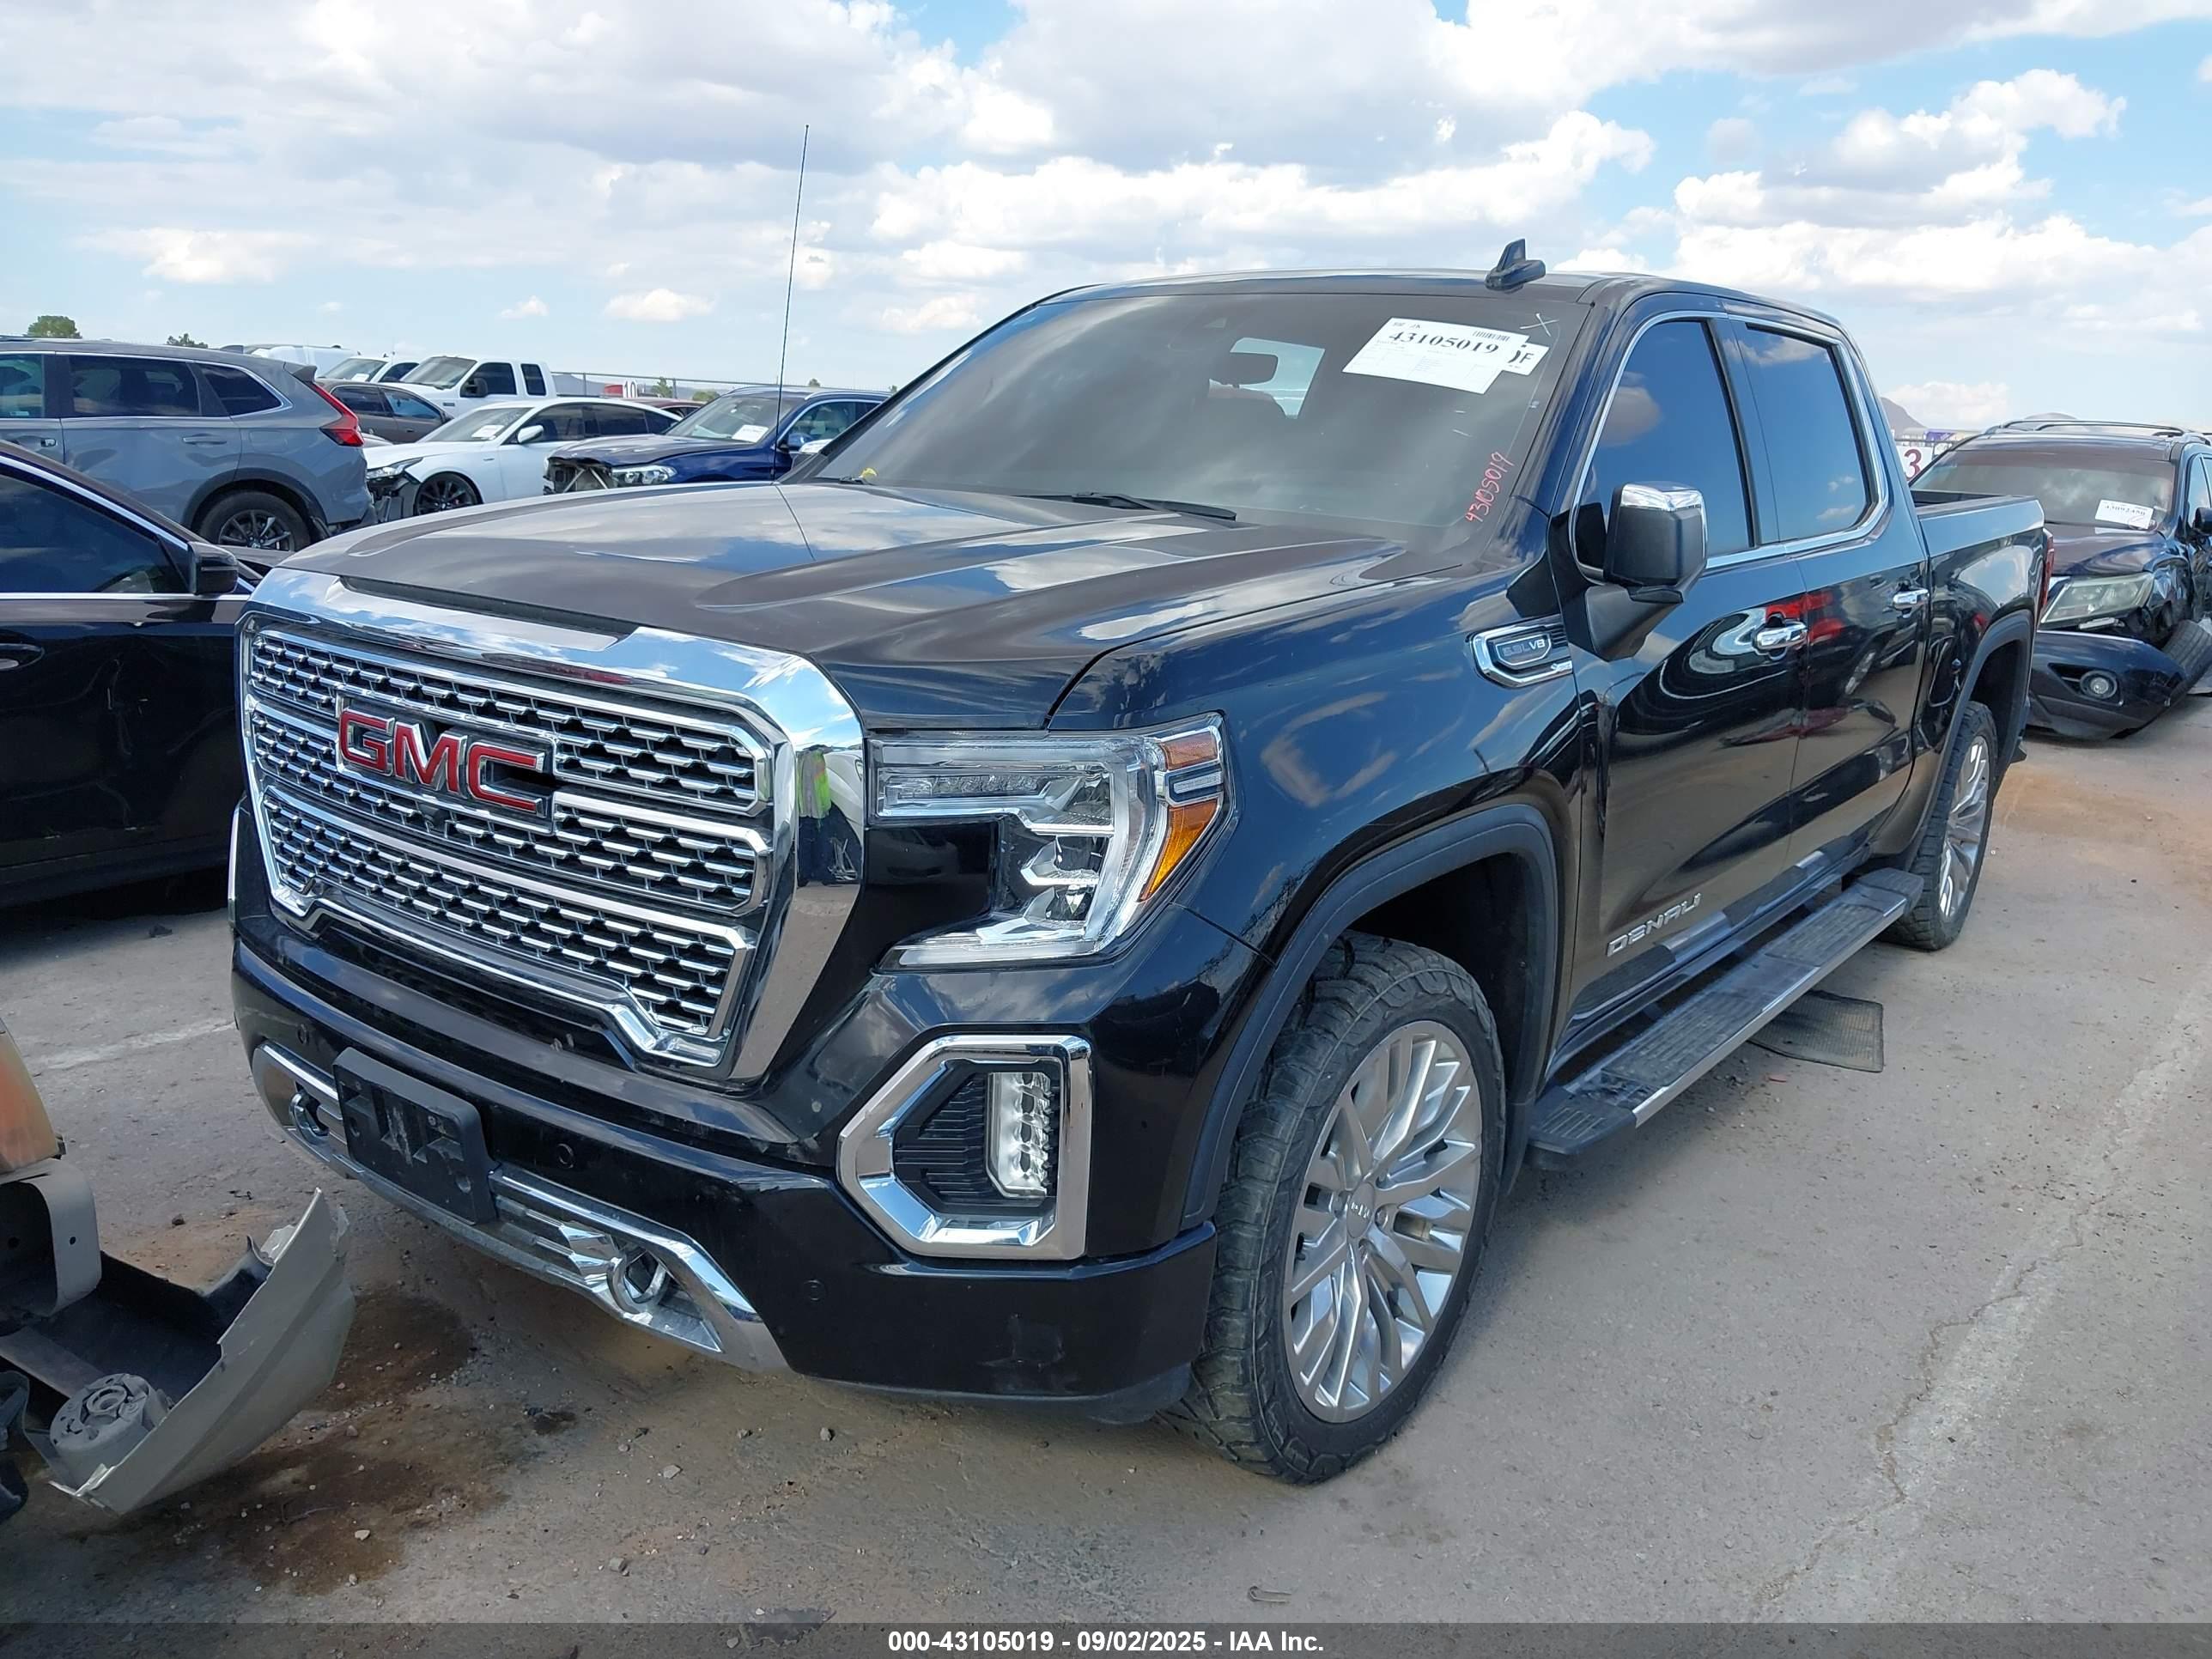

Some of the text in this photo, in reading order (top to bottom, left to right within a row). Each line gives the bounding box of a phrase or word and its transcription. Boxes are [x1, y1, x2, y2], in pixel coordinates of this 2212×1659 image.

[1389, 331, 1499, 355] 43105019
[1465, 452, 1515, 522] 43105019
[339, 708, 547, 817] GMC
[1607, 893, 1701, 957] DENALI
